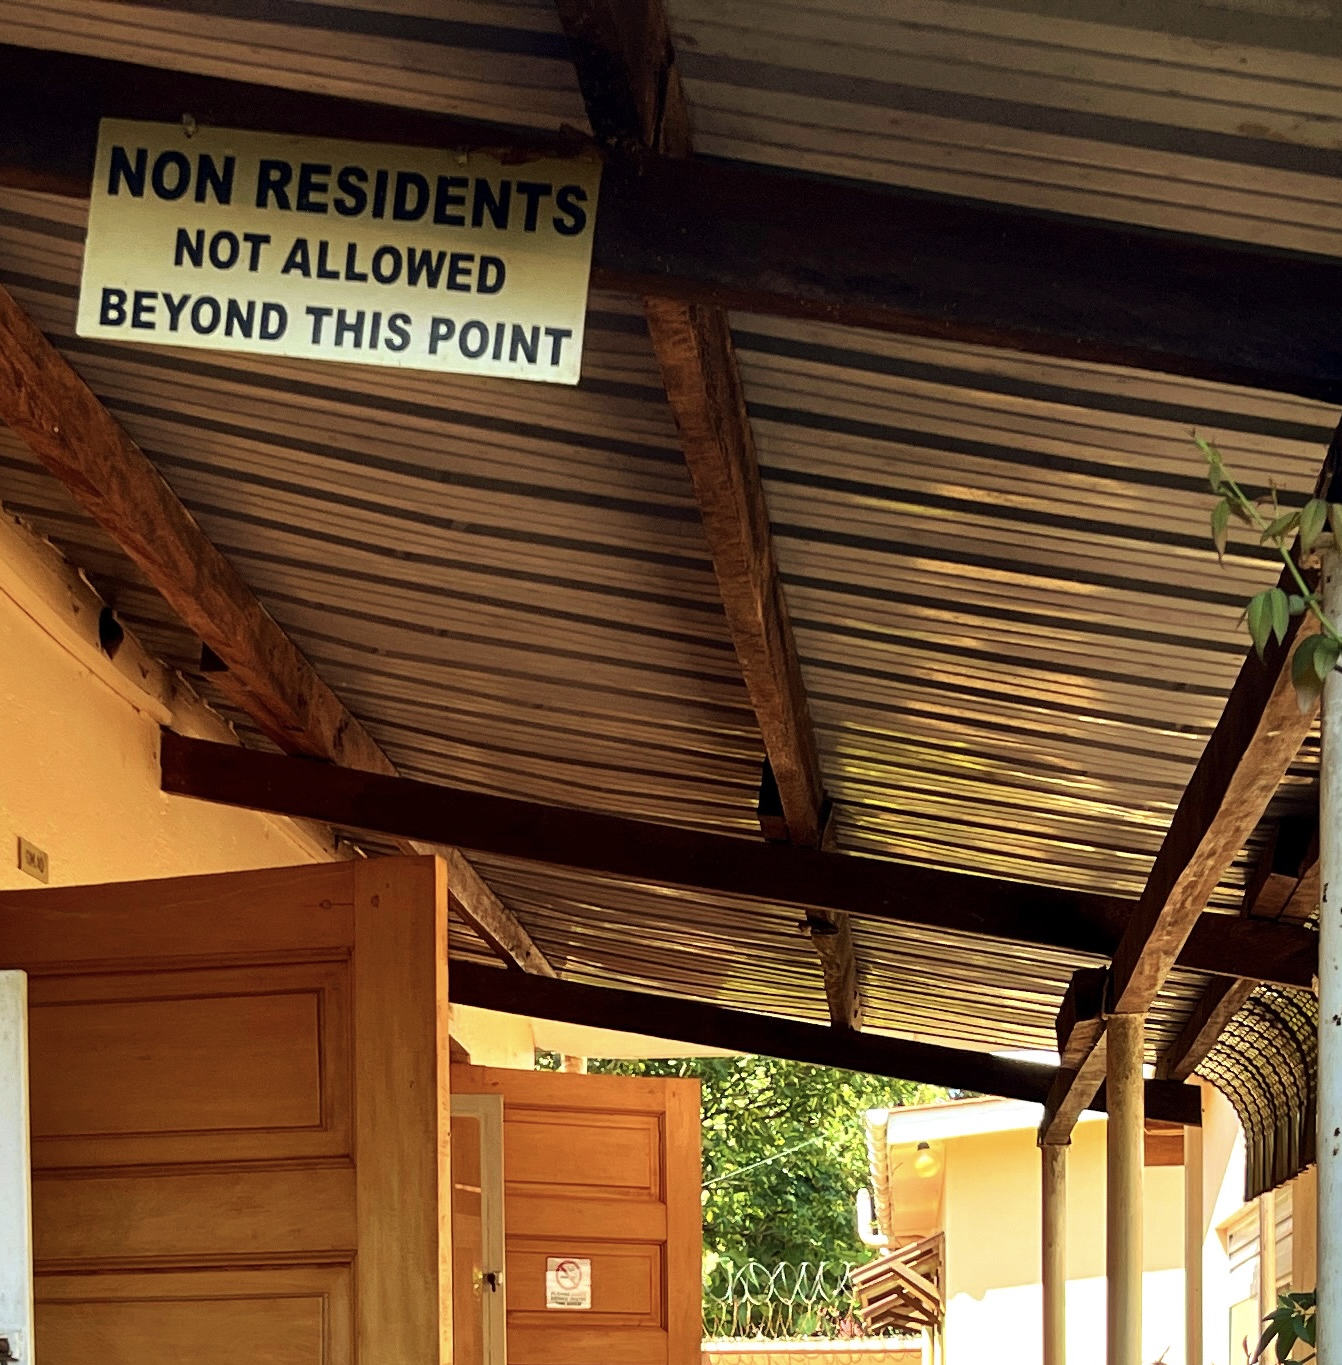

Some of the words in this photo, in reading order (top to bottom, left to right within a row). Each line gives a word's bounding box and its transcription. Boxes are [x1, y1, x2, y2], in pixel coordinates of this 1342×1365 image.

[107, 145, 236, 205] NON
[255, 159, 588, 236] RESIDENTS
[173, 227, 272, 272] NOT
[281, 238, 506, 295] ALLOWED
[99, 287, 288, 341] BEYOND
[305, 306, 412, 352] THIS
[428, 317, 573, 367] POINT
